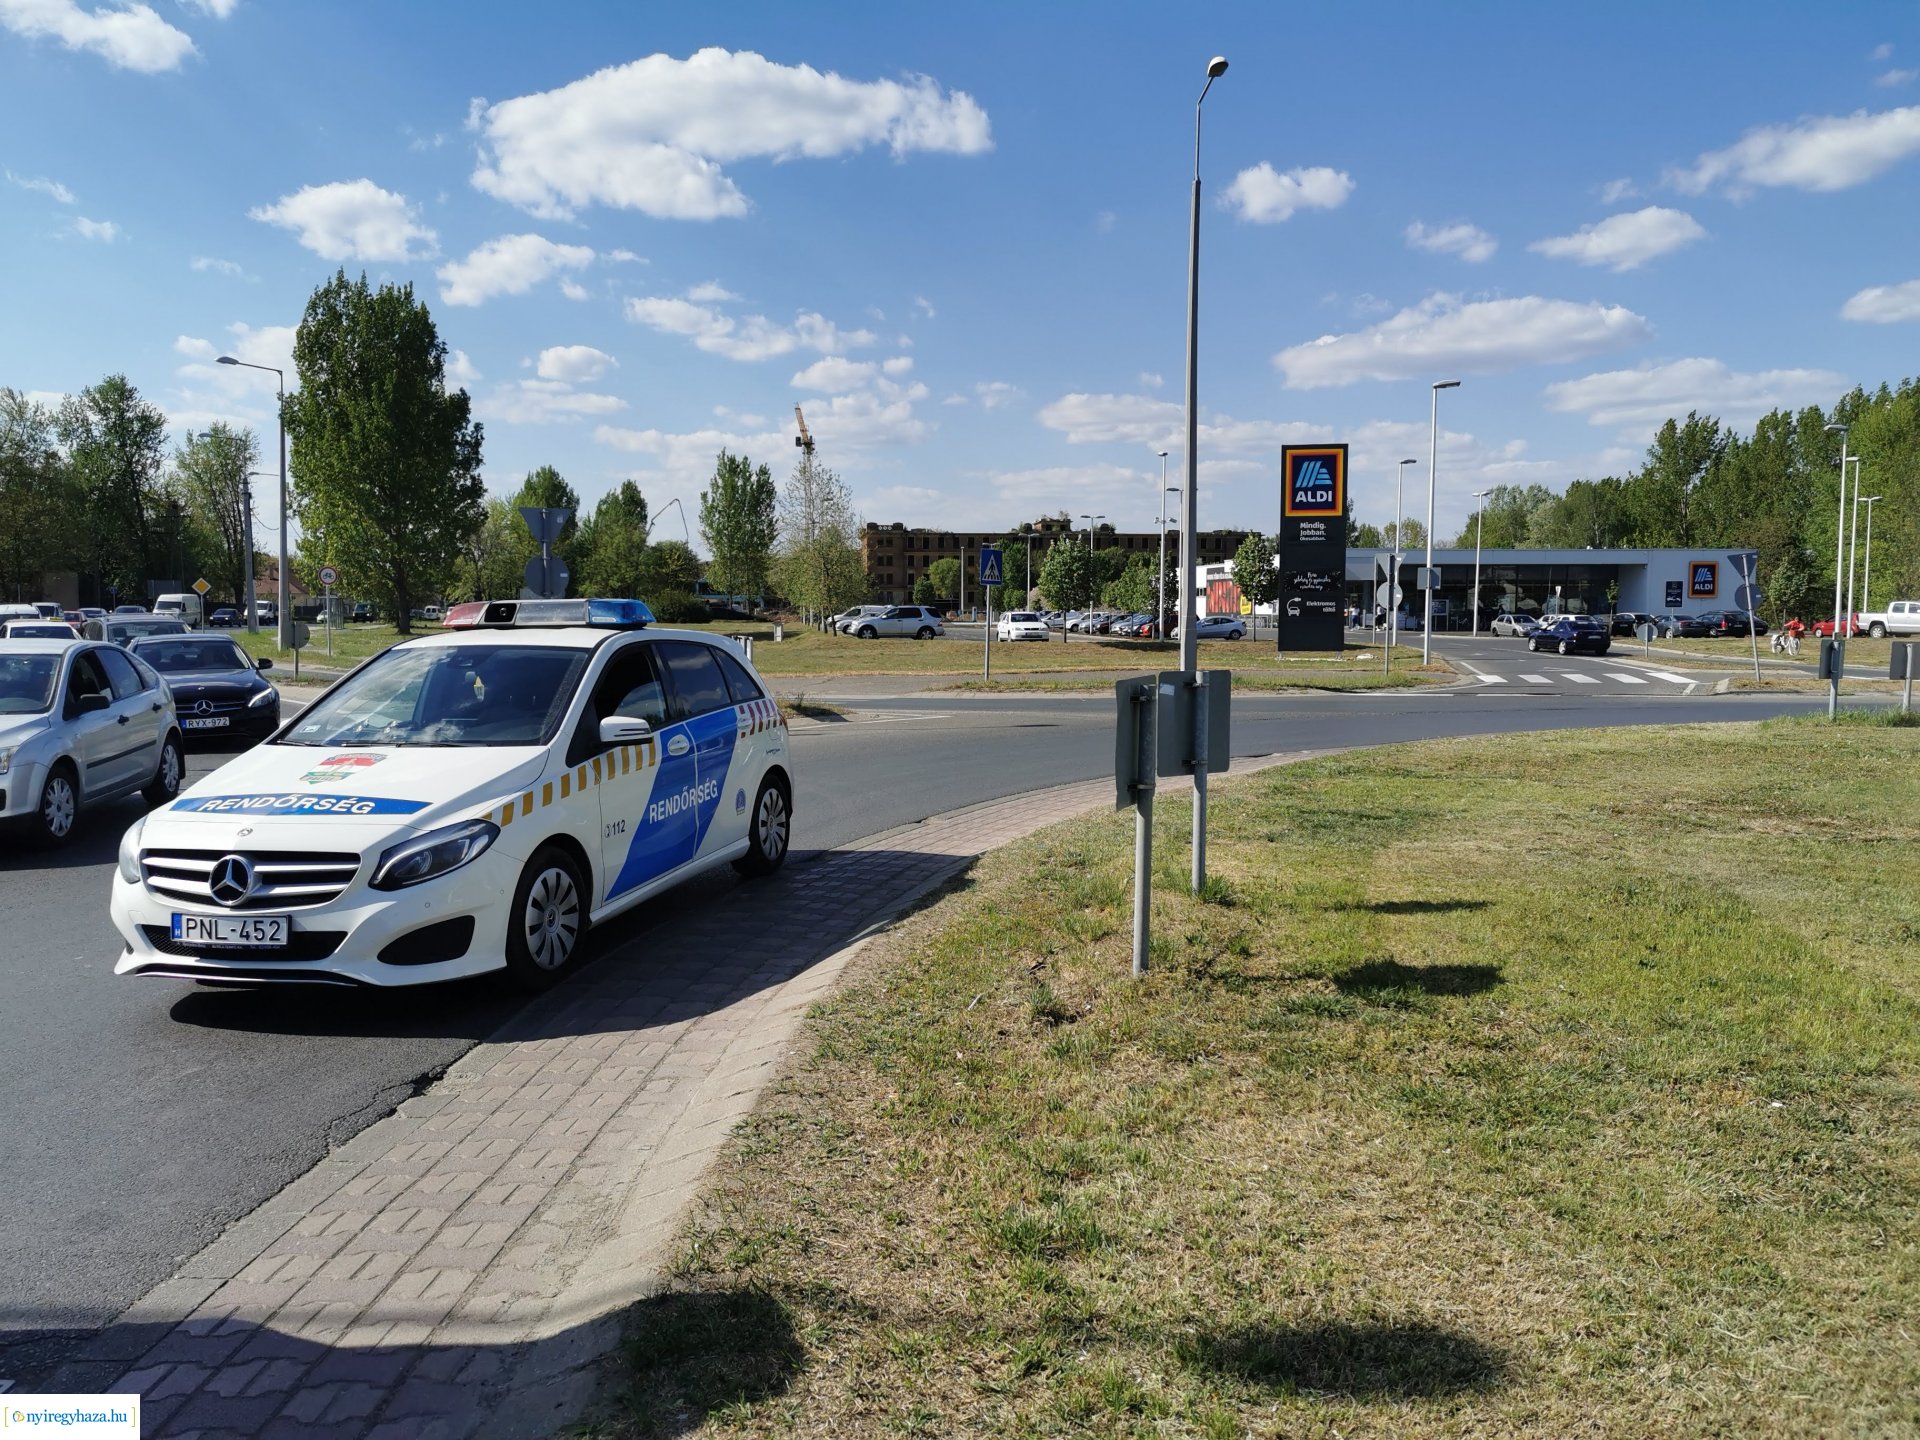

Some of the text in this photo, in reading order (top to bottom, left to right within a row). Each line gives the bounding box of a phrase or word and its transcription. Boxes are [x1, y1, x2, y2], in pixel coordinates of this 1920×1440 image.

[1295, 490, 1333, 503] ALDI
[1299, 521, 1327, 530] Mindig.
[1694, 583, 1713, 591] ALDI
[188, 718, 228, 728] RYX-972
[199, 794, 375, 815] RENDŐRSÉG
[649, 778, 718, 824] RENDŐRSÉG
[612, 819, 626, 836] 112
[174, 917, 281, 942] H PNL-452
